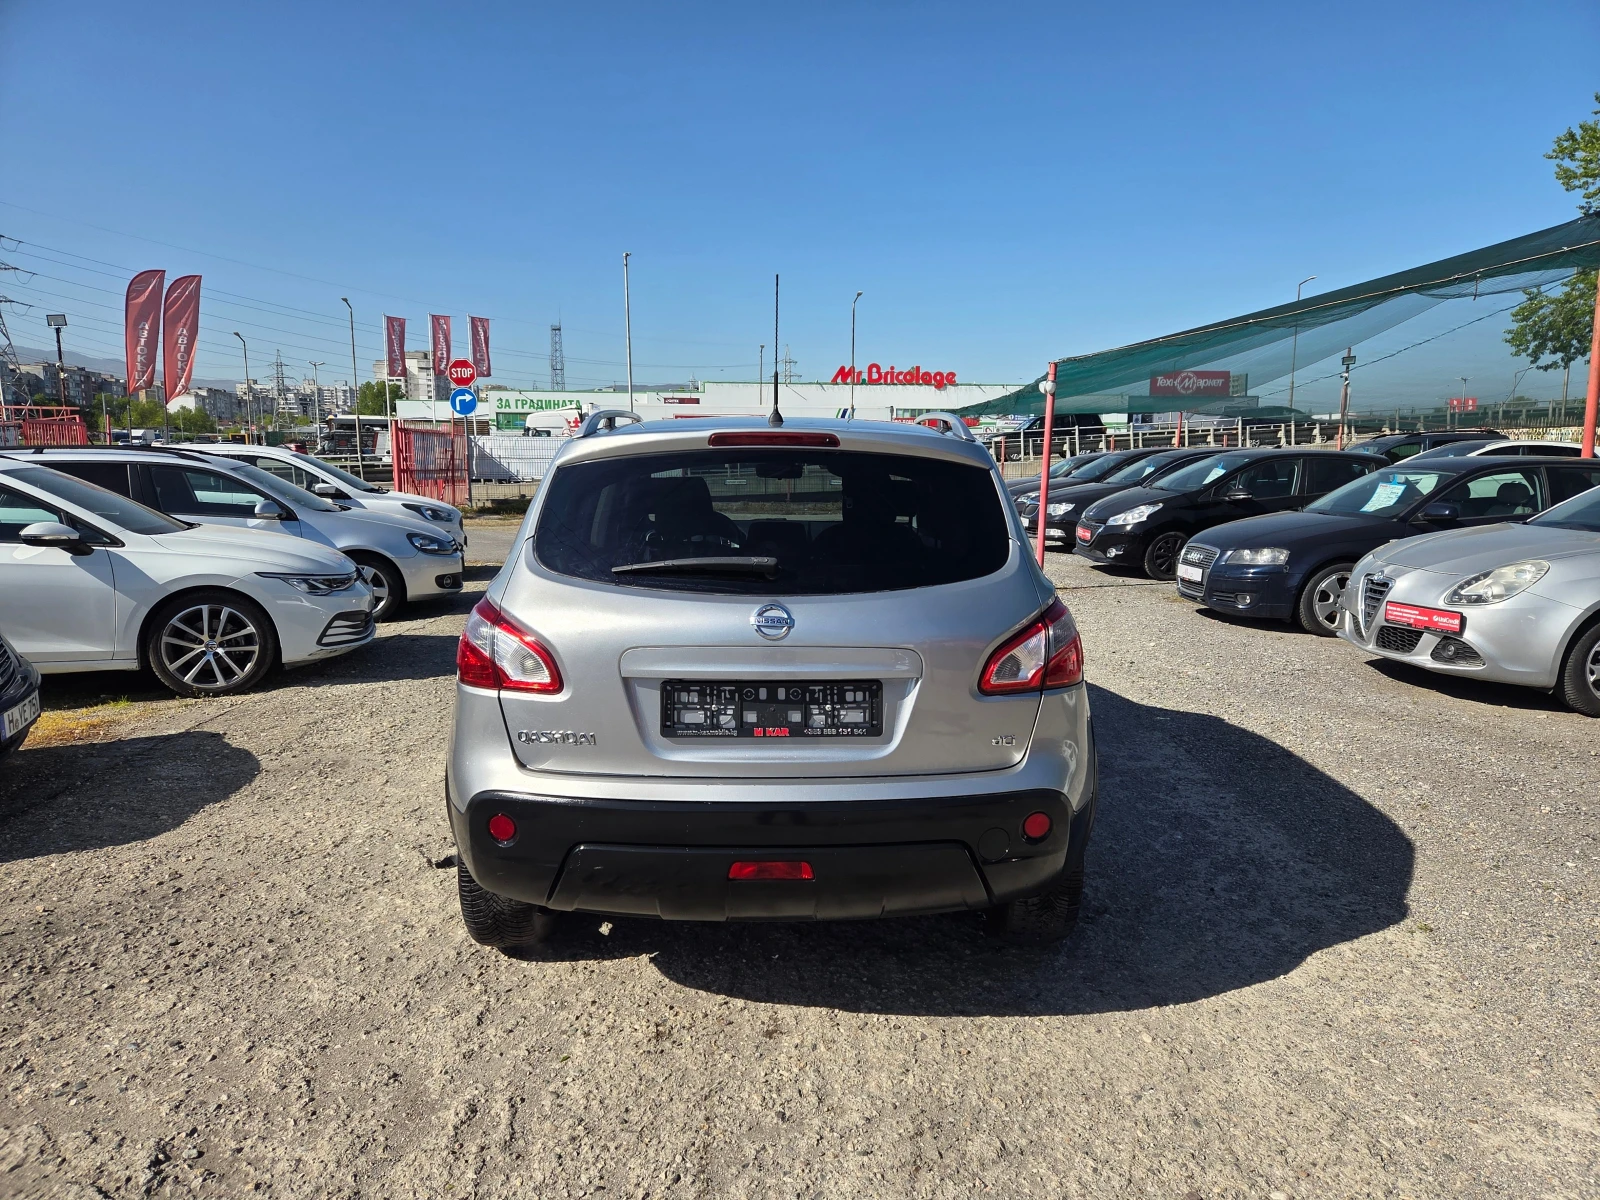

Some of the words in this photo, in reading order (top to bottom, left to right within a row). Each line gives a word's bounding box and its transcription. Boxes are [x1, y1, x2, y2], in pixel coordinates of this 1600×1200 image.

[451, 367, 473, 378] STOP
[831, 363, 957, 389] Mr.Bricolage
[496, 399, 511, 410] ЗА
[514, 399, 582, 411] ГРАДИНАТА
[754, 617, 790, 625] NISSAN
[1438, 616, 1460, 625] UniCredit
[7, 711, 15, 733] H
[765, 727, 790, 737] KAR
[838, 727, 852, 736] 131
[517, 730, 597, 746] QASHQAI
